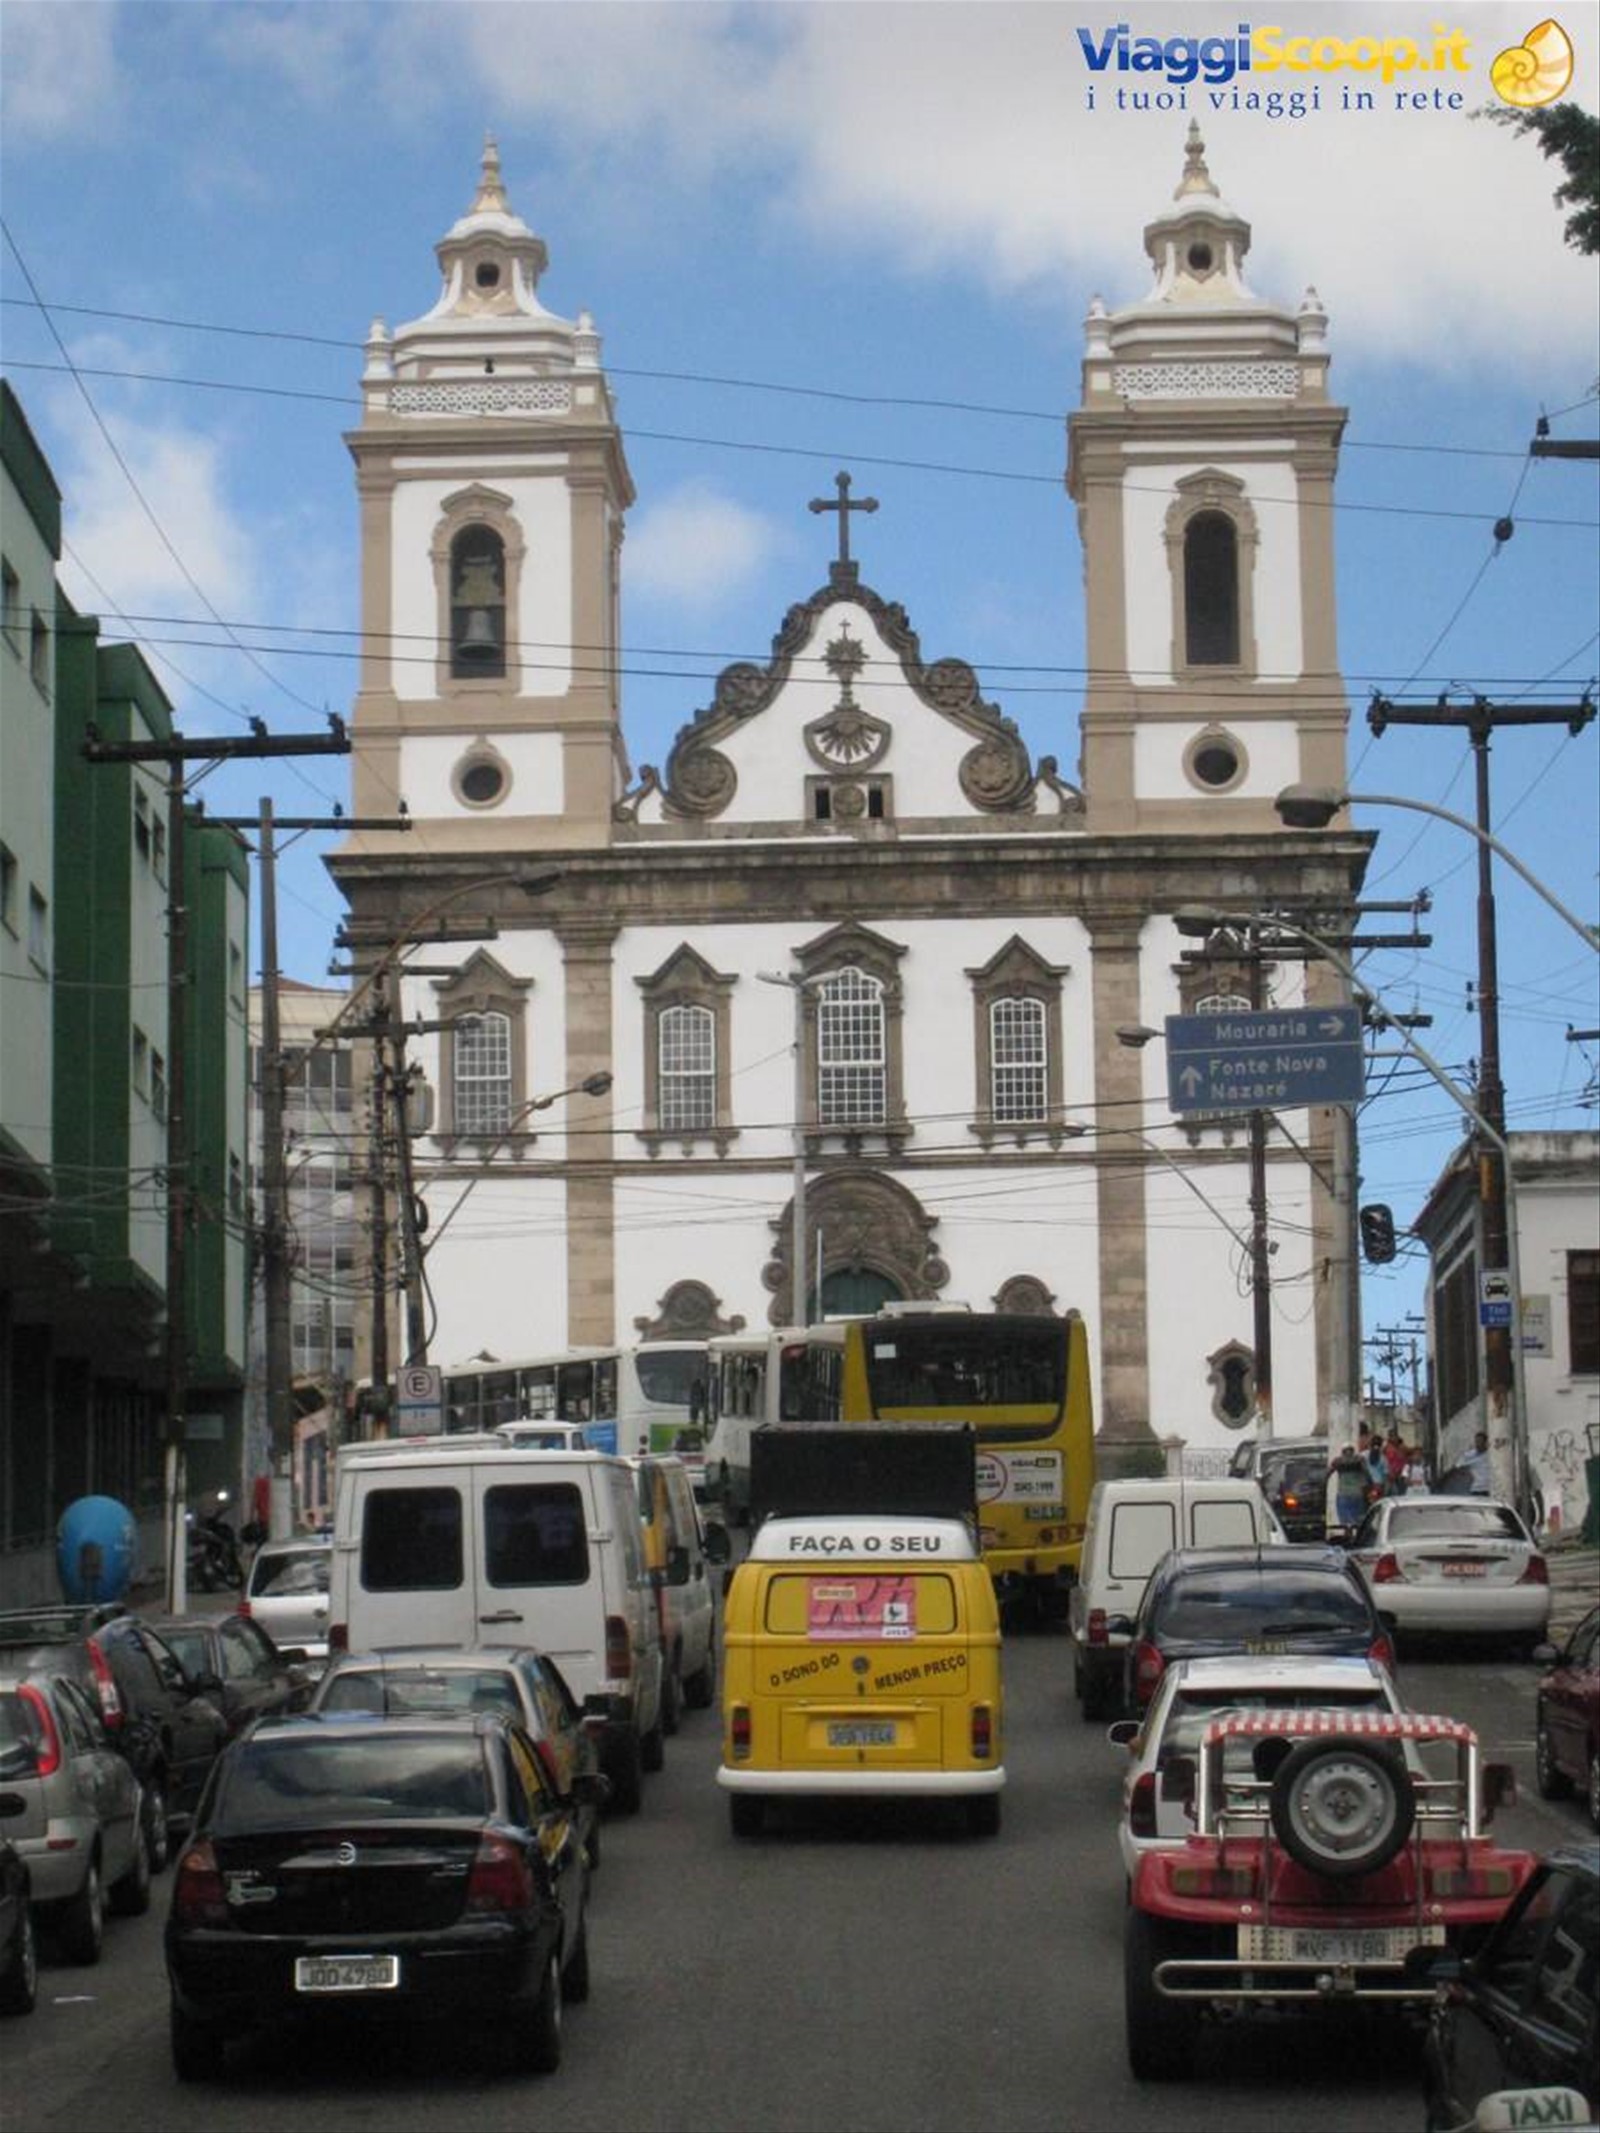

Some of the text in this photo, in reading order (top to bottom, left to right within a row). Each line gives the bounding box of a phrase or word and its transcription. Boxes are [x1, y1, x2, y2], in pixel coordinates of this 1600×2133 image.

[1215, 1019, 1307, 1041] Mouraria
[1208, 1055, 1327, 1076] Fonte Nova
[1210, 1081, 1288, 1100] Nazaré
[412, 1376, 426, 1392] E
[789, 1535, 941, 1554] FAÇA O SEU
[770, 1653, 840, 1688] O DONO DO
[874, 1654, 967, 1691] MENOR PREÇO
[1499, 2093, 1574, 2126] TAXI
